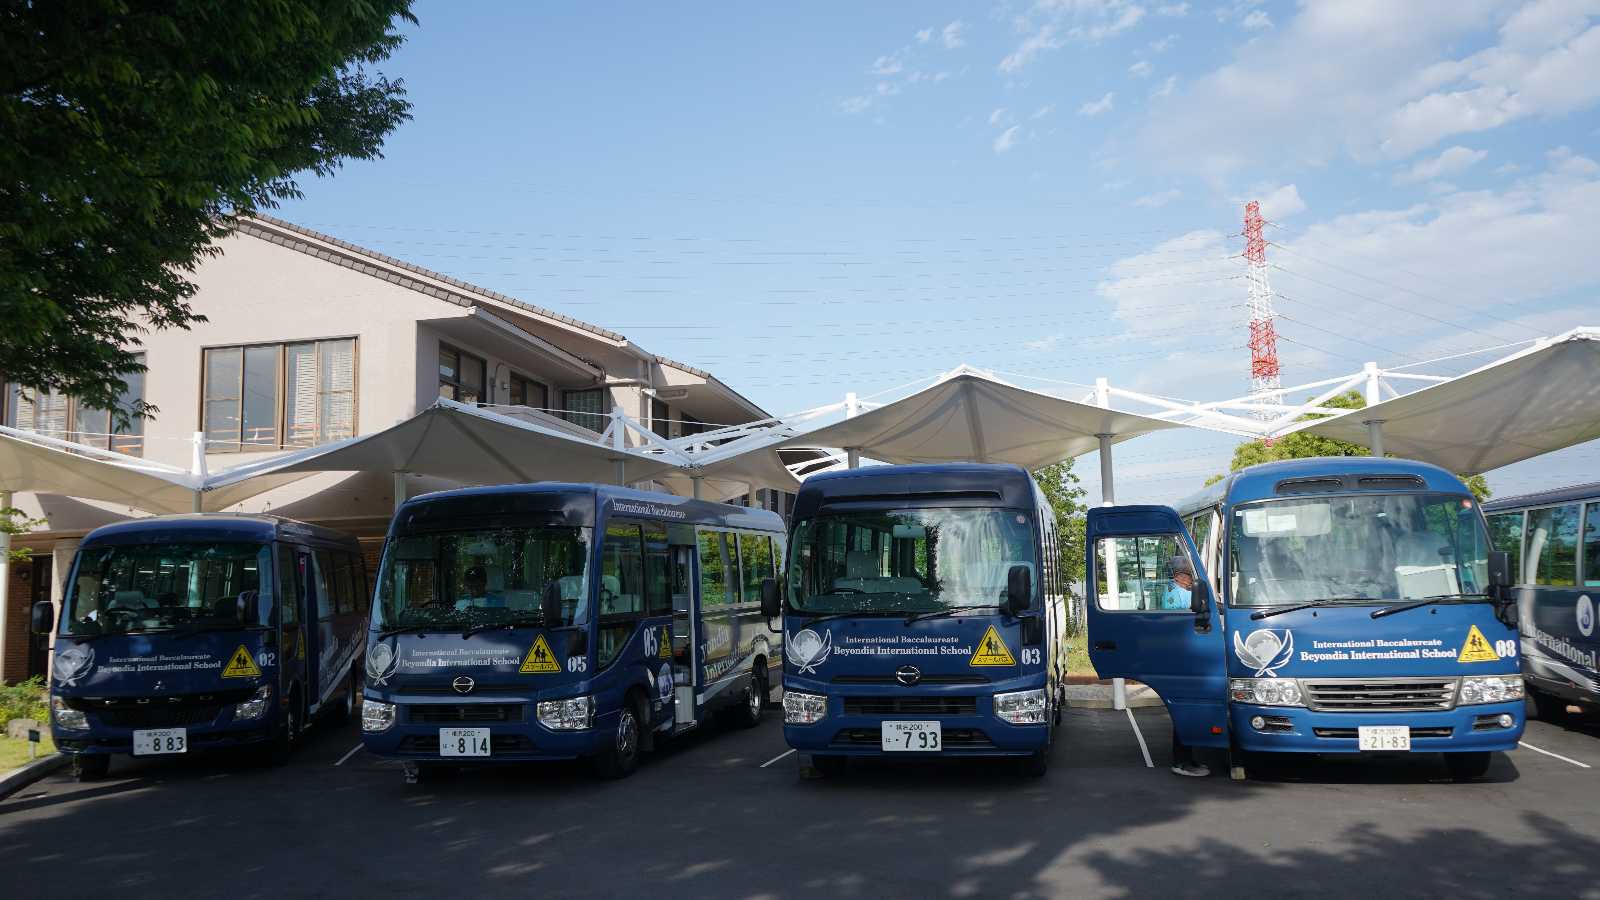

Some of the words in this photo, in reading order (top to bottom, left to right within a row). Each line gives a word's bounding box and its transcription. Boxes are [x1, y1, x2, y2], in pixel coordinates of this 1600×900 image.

[643, 626, 658, 657] 05
[846, 636, 899, 644] International
[901, 636, 959, 644] Baccalaureate
[1312, 640, 1374, 649] International
[1377, 638, 1442, 648] Baccalaureate
[834, 647, 875, 657] Beyondia
[877, 646, 939, 655] International
[940, 646, 972, 655] School
[1495, 639, 1516, 658] 08
[259, 653, 276, 667] 02
[436, 658, 491, 667] International
[492, 656, 521, 666] School
[1021, 648, 1041, 665] 03
[1300, 651, 1349, 662] Beyondia
[1350, 650, 1421, 661] International
[1422, 649, 1457, 659] School
[137, 662, 192, 672] International
[193, 660, 222, 669] School
[567, 656, 587, 673] 05
[1370, 736, 1408, 749] 21-83
